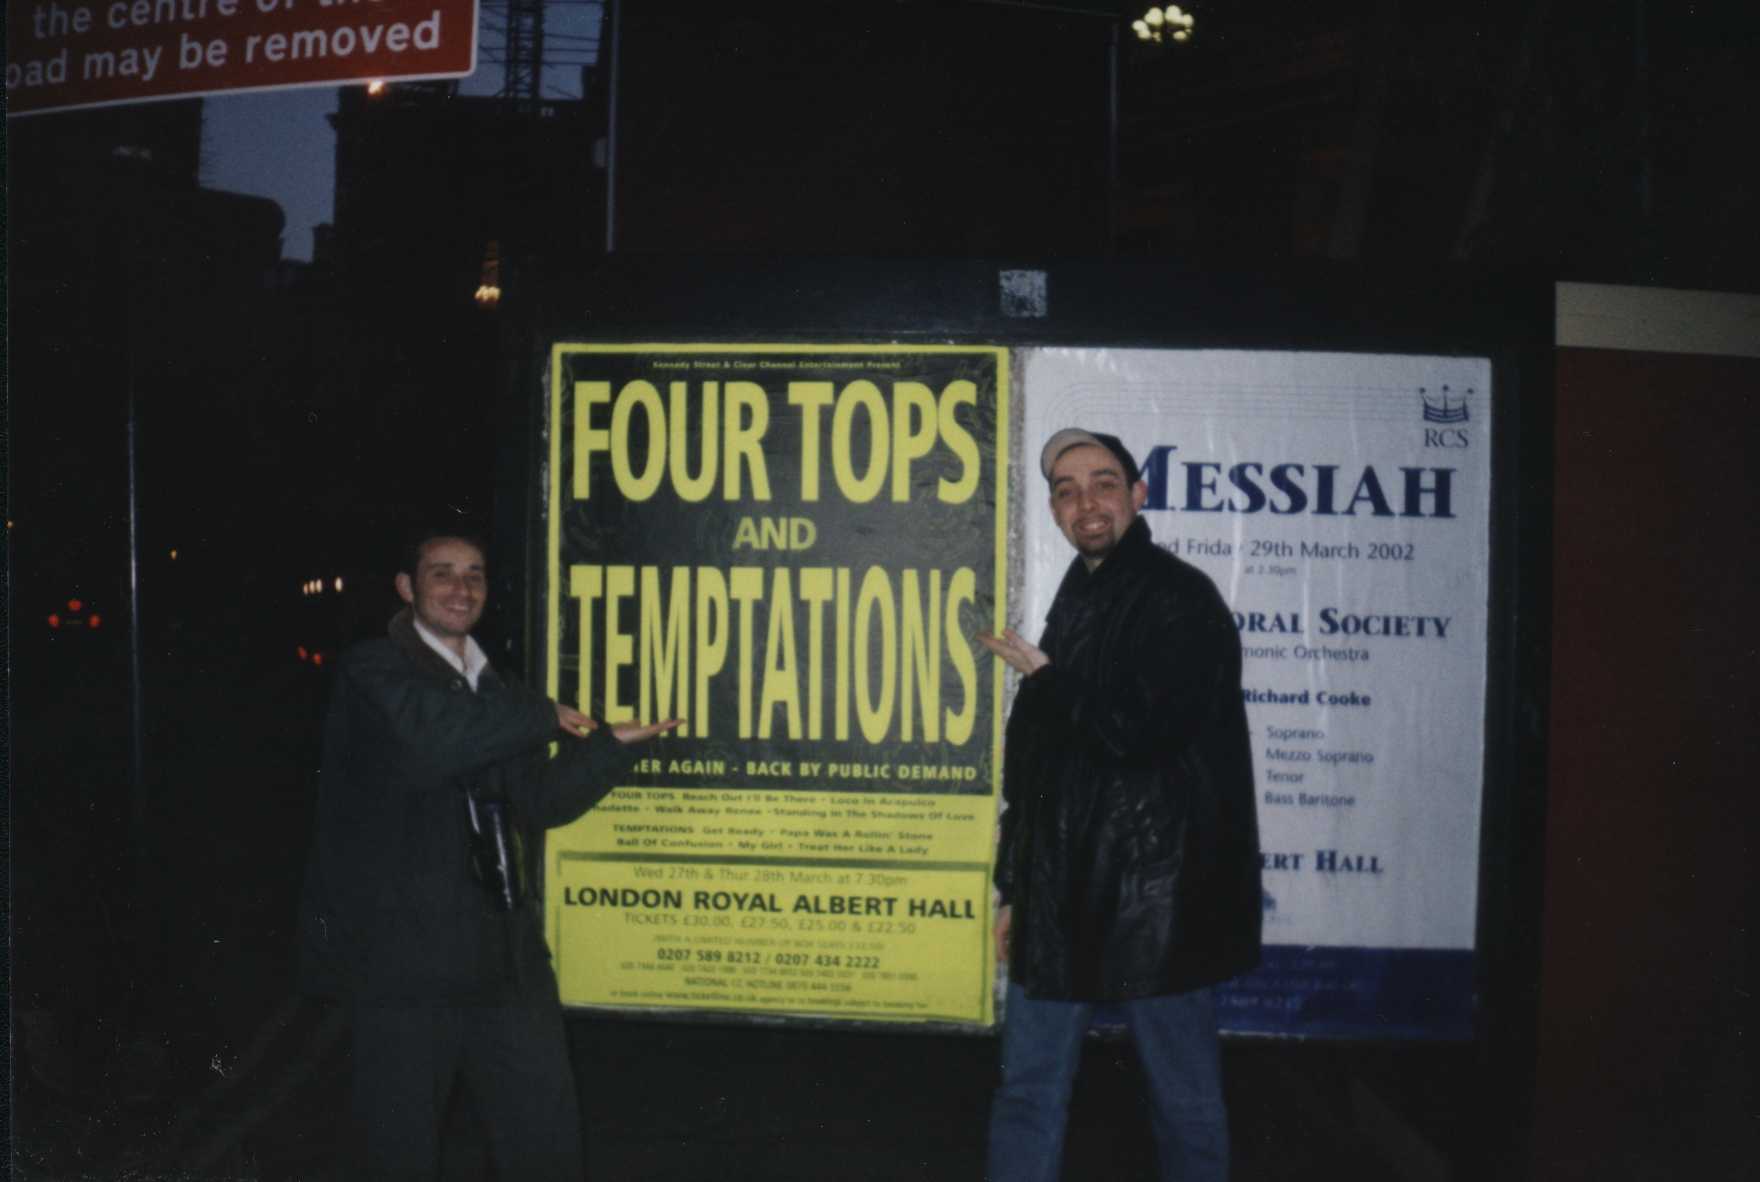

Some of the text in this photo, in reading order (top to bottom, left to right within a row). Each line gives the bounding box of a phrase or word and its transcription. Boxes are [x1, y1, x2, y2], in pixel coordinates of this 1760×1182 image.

[33, 0, 236, 39] the centre
[83, 45, 163, 81] may
[179, 33, 228, 69] be
[245, 10, 440, 63] removed
[573, 379, 980, 504] FOUR TOPS
[1424, 428, 1469, 449] RCS
[732, 516, 817, 551] AND
[1187, 538, 1243, 556] Frida
[1250, 540, 1293, 558] 29th
[1300, 541, 1360, 560] March
[1367, 543, 1416, 561] 2002
[1319, 607, 1452, 638] SOCIETY
[570, 565, 978, 746] TEMPTATIONS
[1294, 645, 1370, 661] Orchestra
[1243, 688, 1371, 706] Richard Cooke
[1267, 726, 1325, 741] Soprano
[1265, 747, 1375, 766] Mezzo Soprano
[634, 760, 661, 774] ER
[669, 760, 725, 776] AGAIN
[746, 761, 792, 777] BACK
[800, 762, 822, 777] BY
[828, 763, 891, 779] PUBLIC
[900, 764, 977, 781] DEMAND
[1266, 769, 1304, 783] Tenor
[611, 791, 642, 801] FOUR
[646, 792, 675, 801] TOPS
[682, 793, 719, 801] Reach
[722, 793, 742, 801] Out
[784, 795, 816, 804] There
[1265, 791, 1355, 807] Bass Baritone
[655, 805, 683, 814] Walk
[688, 806, 720, 816] Away
[613, 824, 695, 834] TEMPTATIONS
[702, 826, 724, 835] Get
[727, 827, 764, 838] Ready
[779, 829, 810, 839] Papa
[813, 829, 838, 838] Was
[842, 830, 851, 838] A
[898, 831, 934, 840] Stone
[616, 838, 640, 847] Ball
[661, 839, 723, 849] Confusion
[738, 841, 756, 851] My
[761, 841, 783, 850] Girl
[885, 846, 896, 854] A
[899, 846, 929, 856] Lady
[1316, 849, 1384, 874] HALL
[633, 866, 664, 879] Wed
[669, 867, 699, 880] 27th
[703, 868, 714, 880] &
[719, 868, 749, 881] Thur
[754, 870, 785, 882] 28th
[790, 871, 832, 884] March
[837, 873, 851, 885] at
[564, 886, 976, 920] LONDON ROYAL ALBERT HALL
[625, 913, 678, 927] TICKETS
[851, 921, 863, 933] &
[657, 947, 691, 962] 0207
[696, 949, 722, 962] 589
[727, 950, 761, 964] 8212
[775, 952, 809, 966] 0207
[815, 954, 841, 967] 434
[846, 955, 880, 969] 2222
